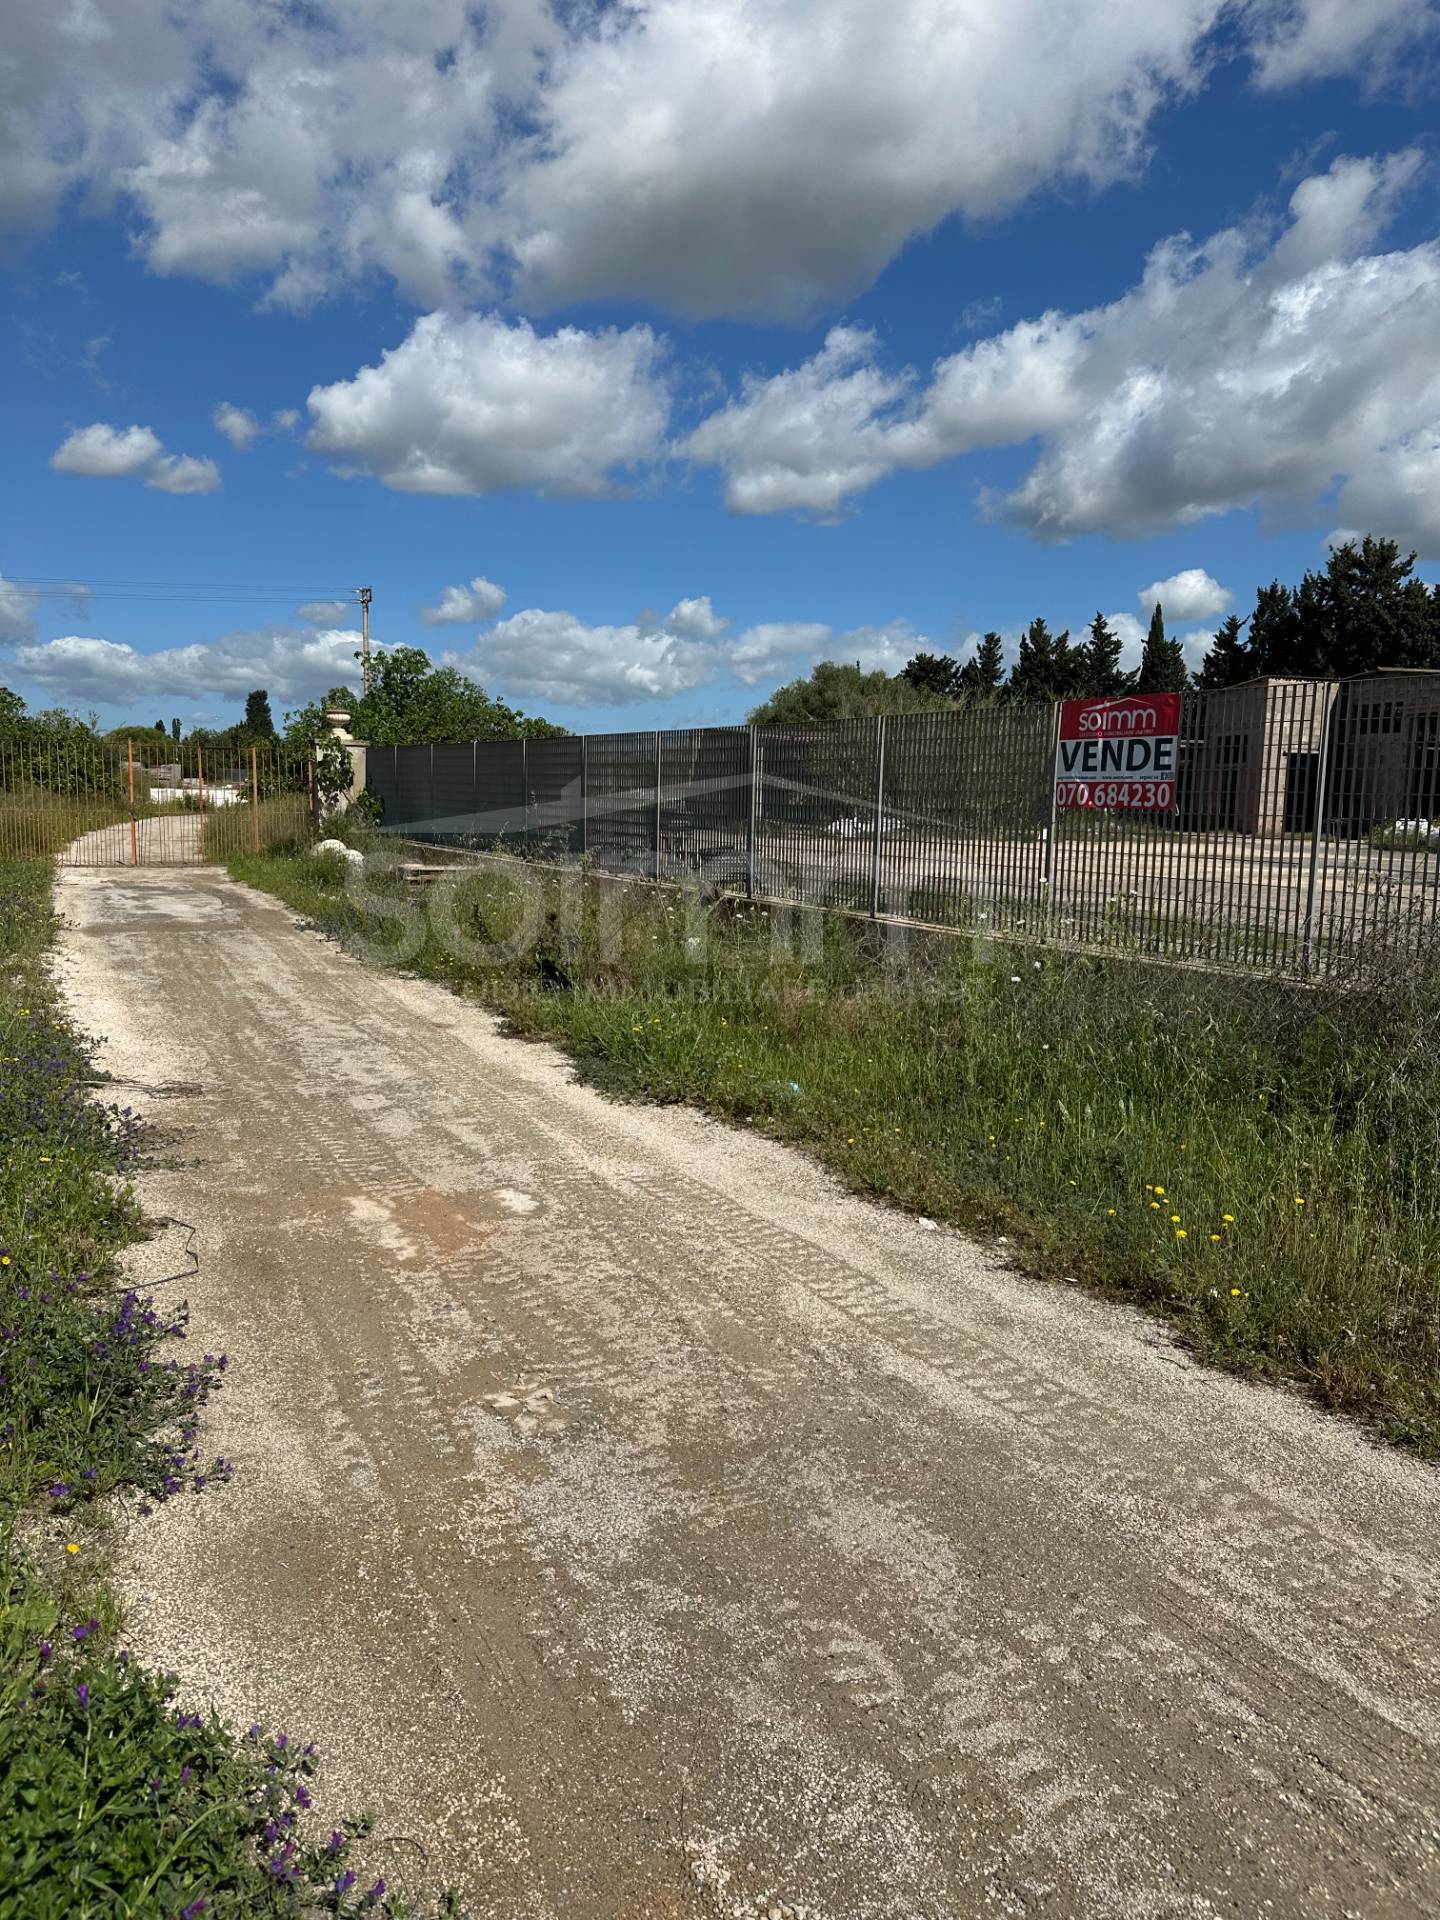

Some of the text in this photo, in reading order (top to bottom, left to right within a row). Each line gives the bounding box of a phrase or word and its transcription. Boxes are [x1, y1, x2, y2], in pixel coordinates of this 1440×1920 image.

[1078, 708, 1157, 731] soimm
[1060, 737, 1173, 772] VENDE
[1056, 783, 1171, 807] 070.684230
